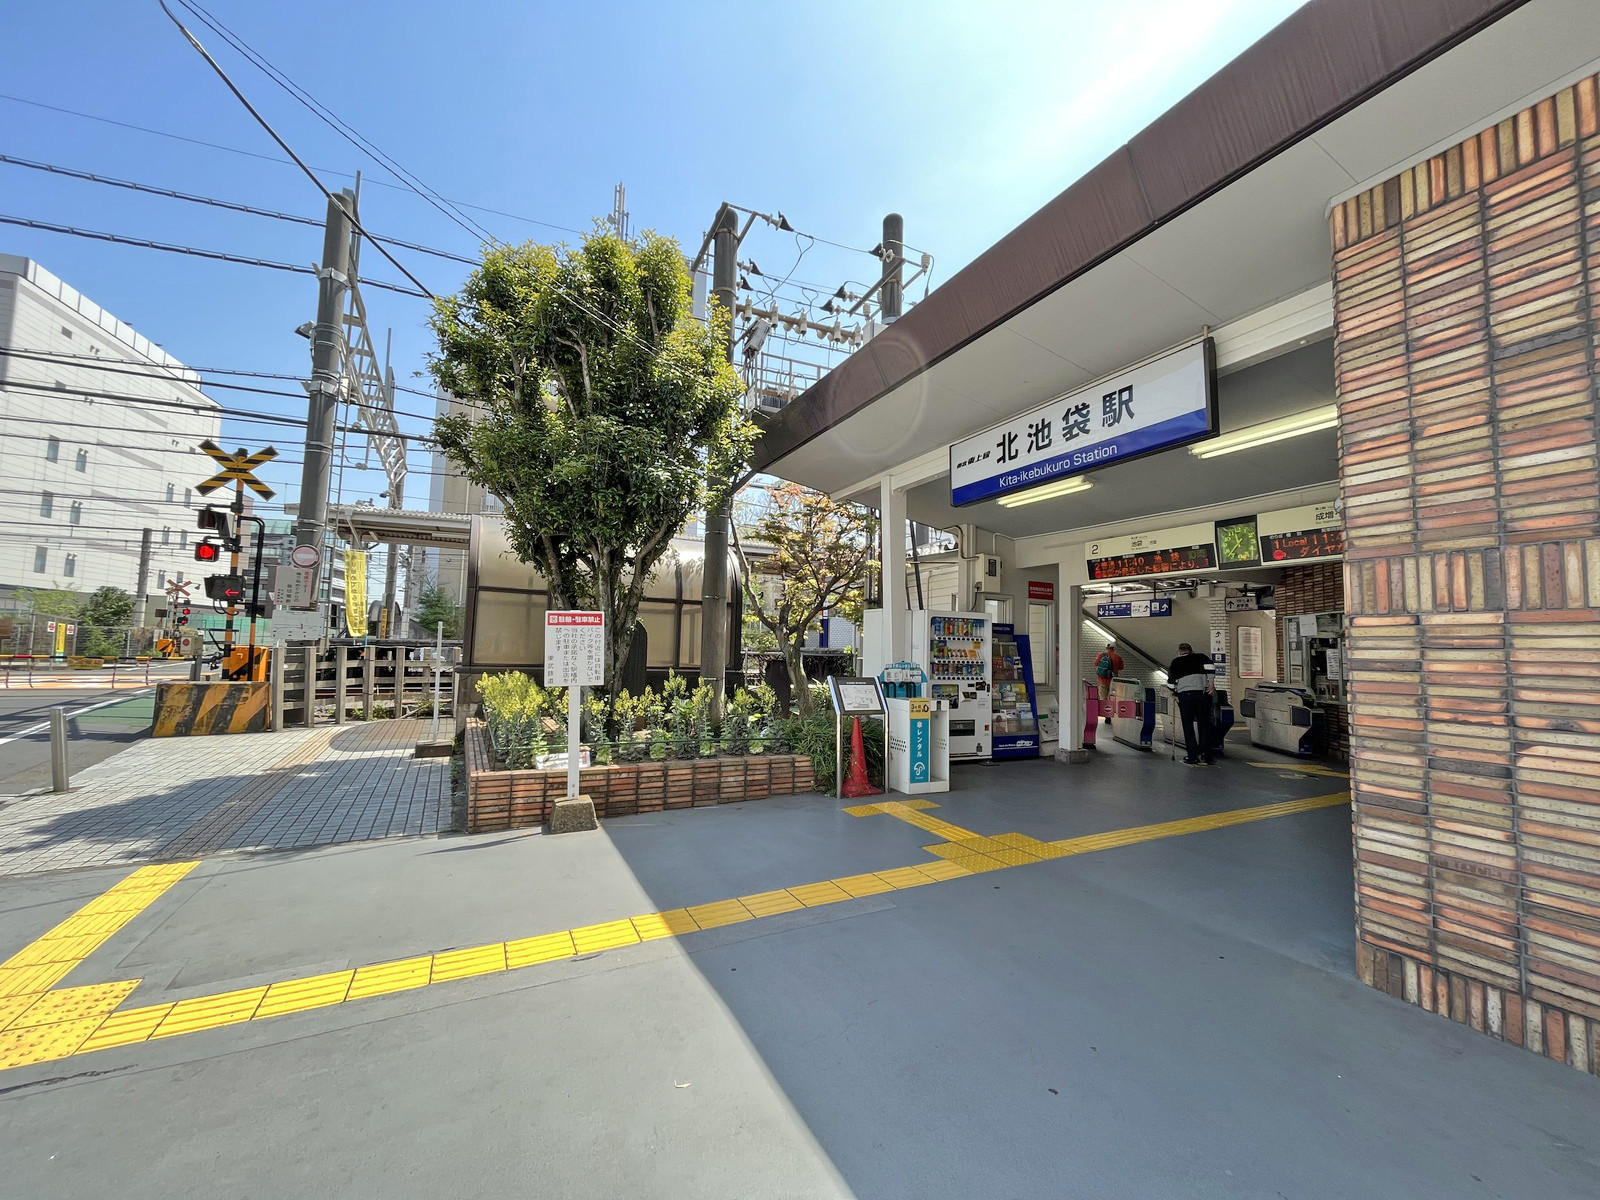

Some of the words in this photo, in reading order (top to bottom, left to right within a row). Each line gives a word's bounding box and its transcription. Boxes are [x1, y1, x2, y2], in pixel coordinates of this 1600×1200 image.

[956, 450, 990, 468] 東武東上線
[996, 384, 1135, 464] 北池袋駅
[999, 458, 1070, 488] Kita-ikebukuro
[1074, 444, 1118, 466] Station
[1092, 544, 1099, 554] 2
[1274, 540, 1280, 549] 1
[1282, 537, 1308, 548] Local
[1118, 557, 1144, 568] 11:40
